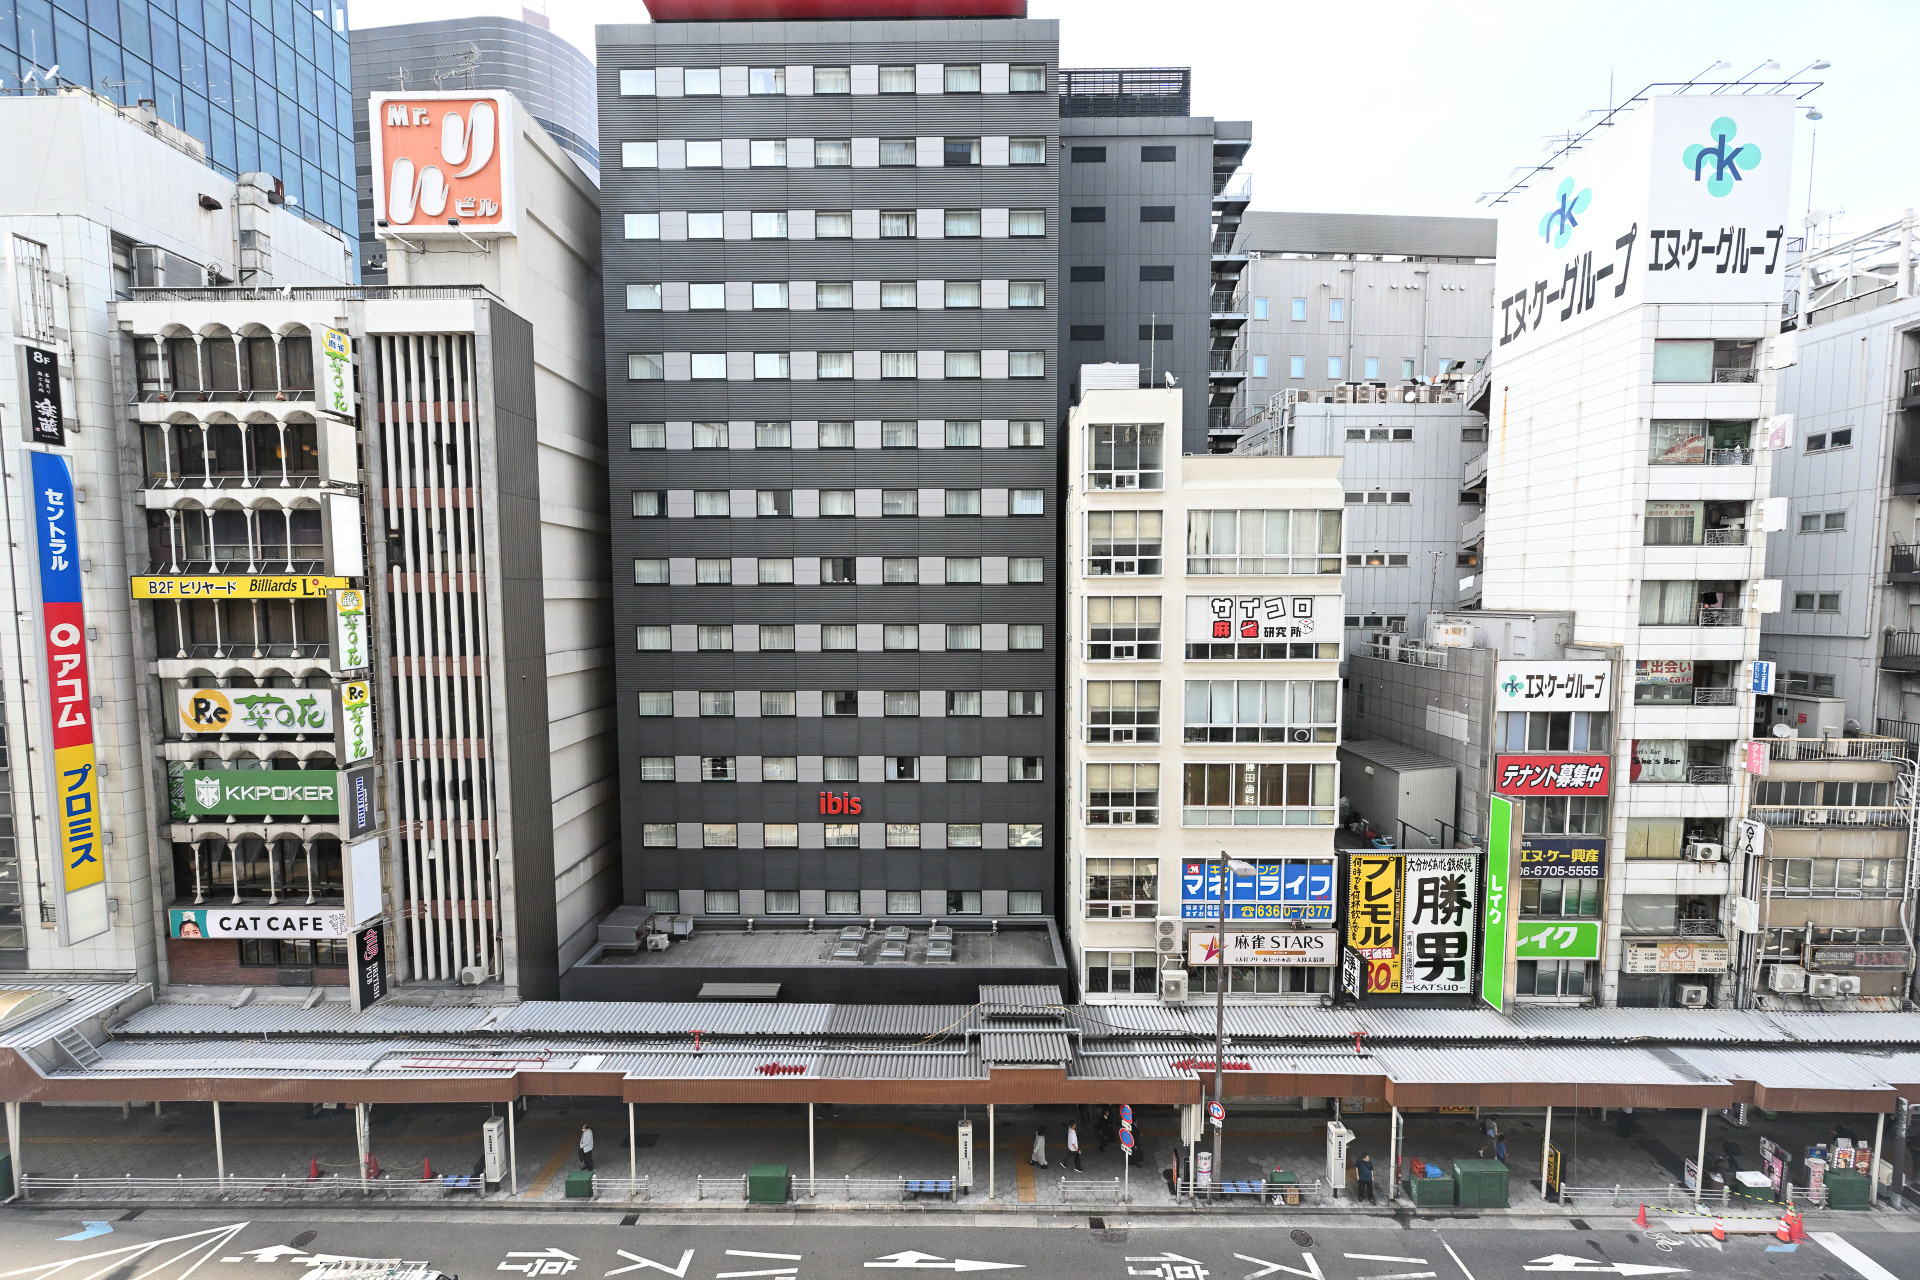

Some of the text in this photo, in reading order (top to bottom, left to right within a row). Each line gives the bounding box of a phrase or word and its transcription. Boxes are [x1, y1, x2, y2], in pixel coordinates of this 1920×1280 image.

[387, 104, 431, 127] Mr.
[455, 197, 499, 218] ビル
[1648, 224, 1784, 275] エヌ・ケーグループ
[1500, 222, 1638, 347] エヌ・ケーグループ
[33, 351, 51, 365] 8F
[44, 488, 69, 572] セントラル
[149, 580, 174, 594] B2F
[179, 580, 237, 595] ビリヤード
[249, 578, 298, 592] Billiards
[1211, 597, 1313, 619] サイコロ
[1650, 660, 1692, 674] 出会い
[53, 653, 87, 728] アコム
[1525, 672, 1606, 699] エヌ・ケーグループ
[1669, 675, 1692, 684] cafe
[1663, 757, 1681, 765] Bar
[1501, 763, 1605, 789] テナント募集中
[225, 785, 335, 801] KKPOKER
[355, 776, 366, 829] UNIVERSE
[819, 791, 862, 815] ibis
[63, 763, 98, 869] プロミス
[1520, 848, 1599, 863] エヌ・ケー興産
[1183, 875, 1331, 896] マネーライフ
[1358, 856, 1396, 947] プレモル
[1488, 874, 1503, 925] レイク
[219, 916, 324, 932] CAT CAFE
[1411, 873, 1472, 982] 勝男
[363, 928, 379, 961] HUB
[1234, 934, 1324, 949] 麻雀 STARS
[365, 965, 373, 985] PUB
[371, 961, 380, 999] BRITISH
[1413, 984, 1459, 992] KATSUO
